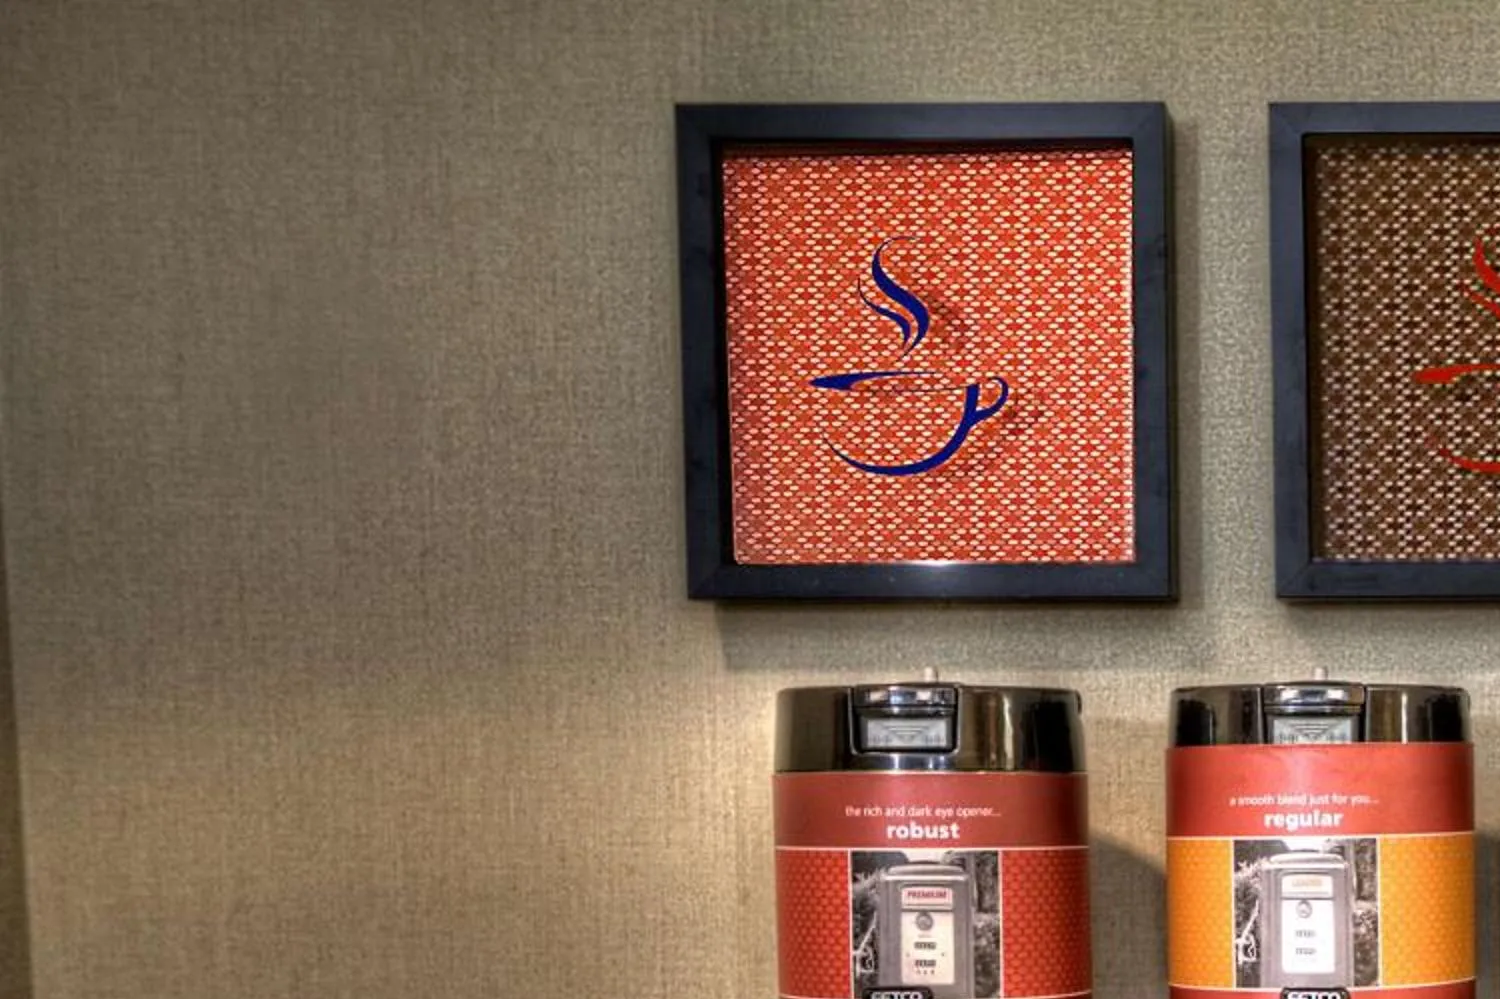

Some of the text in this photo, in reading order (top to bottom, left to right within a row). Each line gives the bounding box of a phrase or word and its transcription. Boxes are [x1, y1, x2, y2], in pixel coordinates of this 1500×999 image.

[1238, 794, 1274, 806] smooth
[1277, 794, 1307, 806] blend
[1309, 794, 1331, 807] just
[1331, 793, 1348, 805] for
[845, 804, 861, 817] the
[863, 804, 882, 817] rich
[885, 804, 905, 817] and
[907, 804, 932, 817] dark
[934, 806, 954, 819] eye
[1263, 809, 1345, 832] regular
[886, 819, 961, 839] robust
[907, 889, 947, 900] PREMIUM
